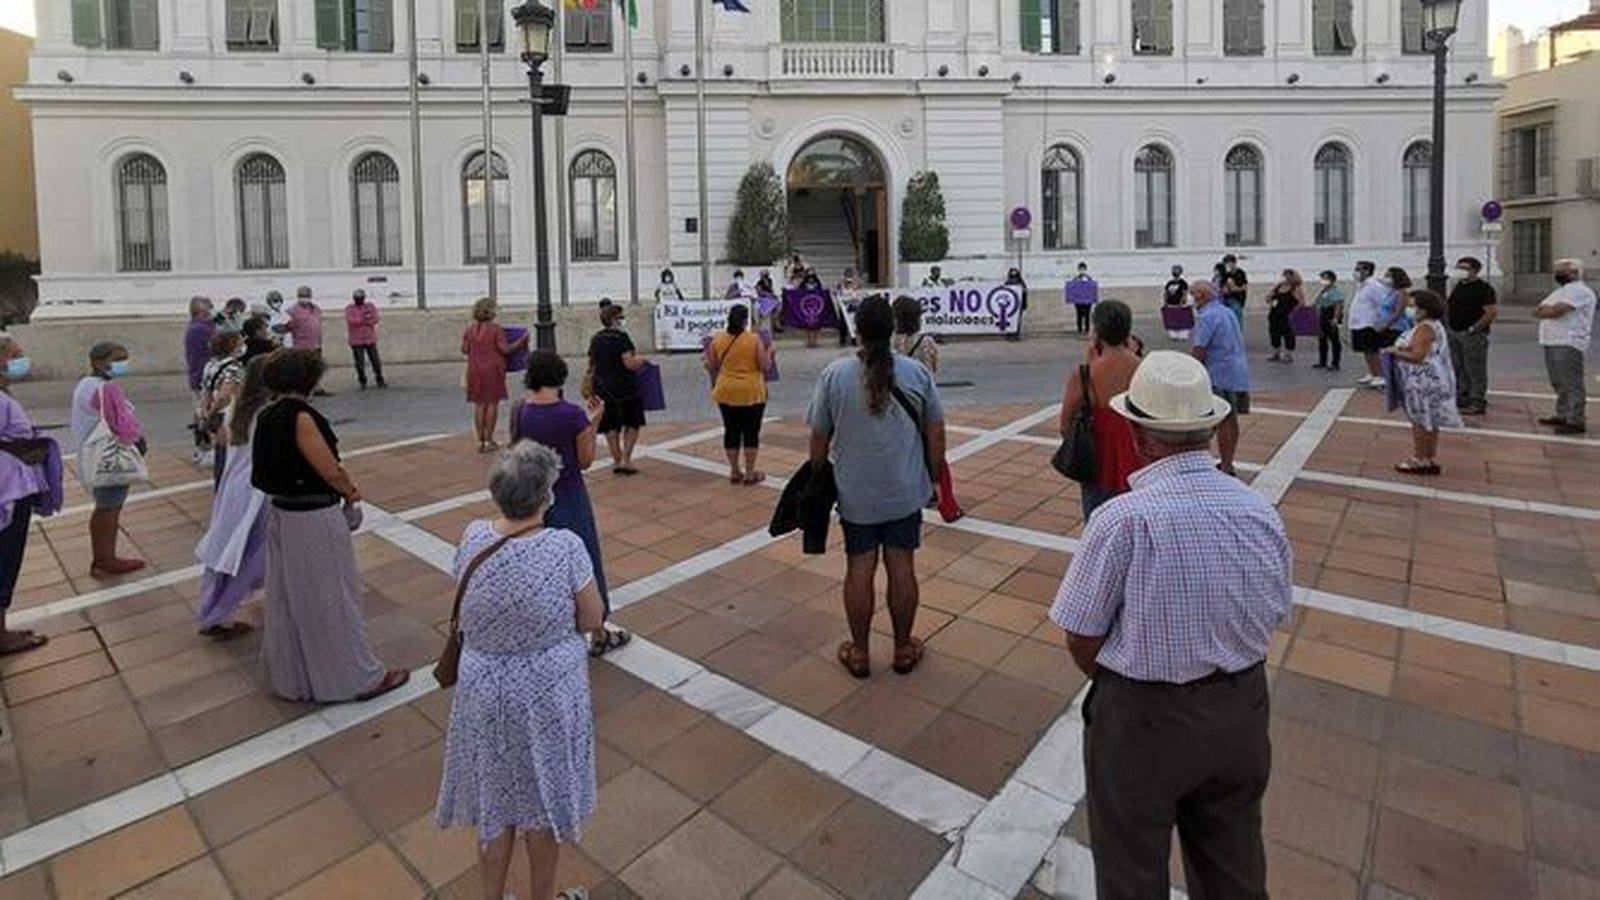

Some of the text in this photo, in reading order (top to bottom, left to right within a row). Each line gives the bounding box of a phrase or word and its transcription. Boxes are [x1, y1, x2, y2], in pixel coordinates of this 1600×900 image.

[950, 290, 981, 312] NO
[674, 318, 725, 332] al poder
